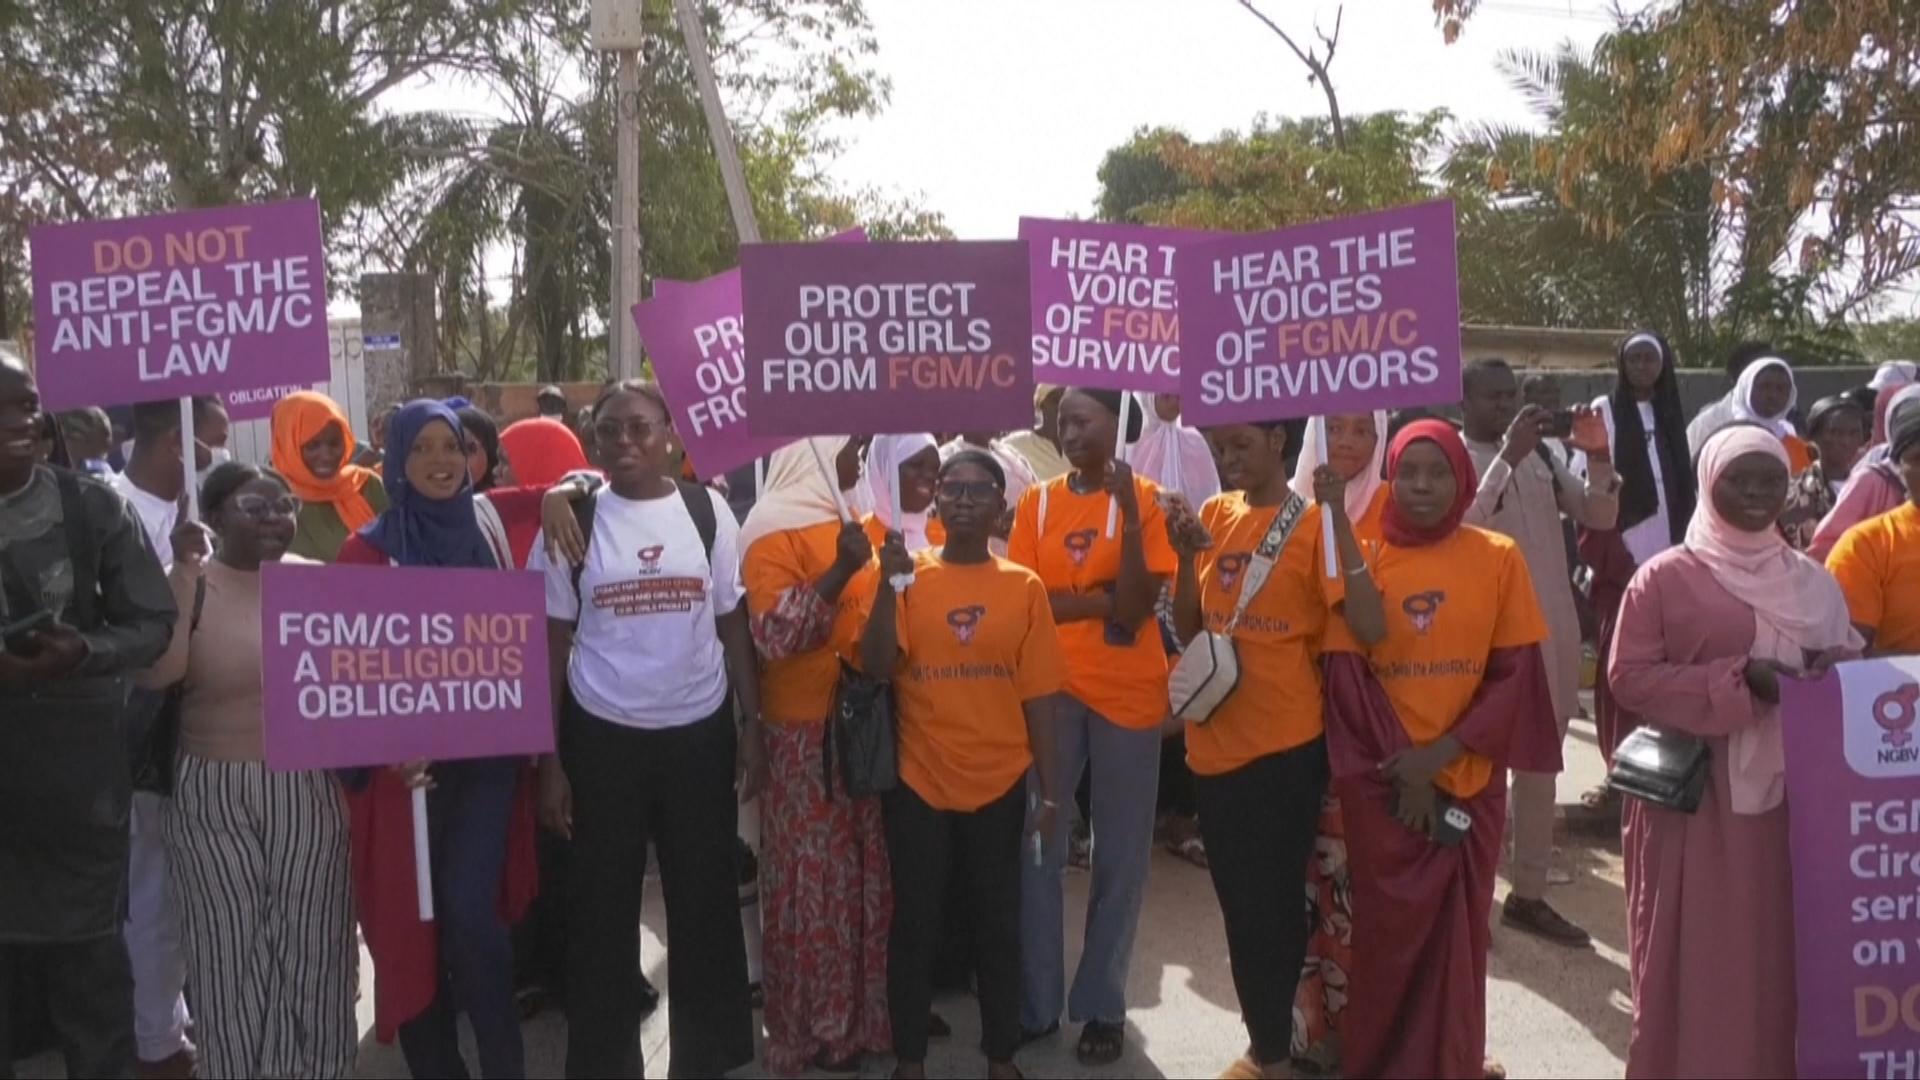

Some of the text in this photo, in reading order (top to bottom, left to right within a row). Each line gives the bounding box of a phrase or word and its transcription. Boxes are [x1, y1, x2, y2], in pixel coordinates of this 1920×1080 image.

[94, 226, 251, 273] DO NOT
[1051, 237, 1148, 275] HEAR
[1213, 227, 1416, 293] HEAR THE
[51, 256, 310, 315] REPEAL THE
[800, 283, 976, 319] PROTECT
[1068, 271, 1178, 309] VOICE
[1233, 274, 1382, 326] VOICES
[52, 294, 312, 352] ANTI-FGM/C
[693, 313, 745, 358] PR
[785, 319, 991, 355] OUR GIRLS
[1046, 303, 1094, 335] OF
[1216, 309, 1418, 366] OF FGM/C
[138, 339, 231, 381] LAW
[695, 348, 746, 394] OU
[763, 354, 1016, 393] FROM FGM/C
[1200, 347, 1439, 405] SURVIVORS
[279, 613, 533, 647] FGM/C IS NOT
[294, 646, 523, 682] A RELIGIOUS
[298, 679, 522, 719] OBLIGATION
[1878, 747, 1919, 764] NGBV
[1850, 799, 1920, 835] FG
[1853, 938, 1905, 966] on
[1859, 1050, 1920, 1079] TH
